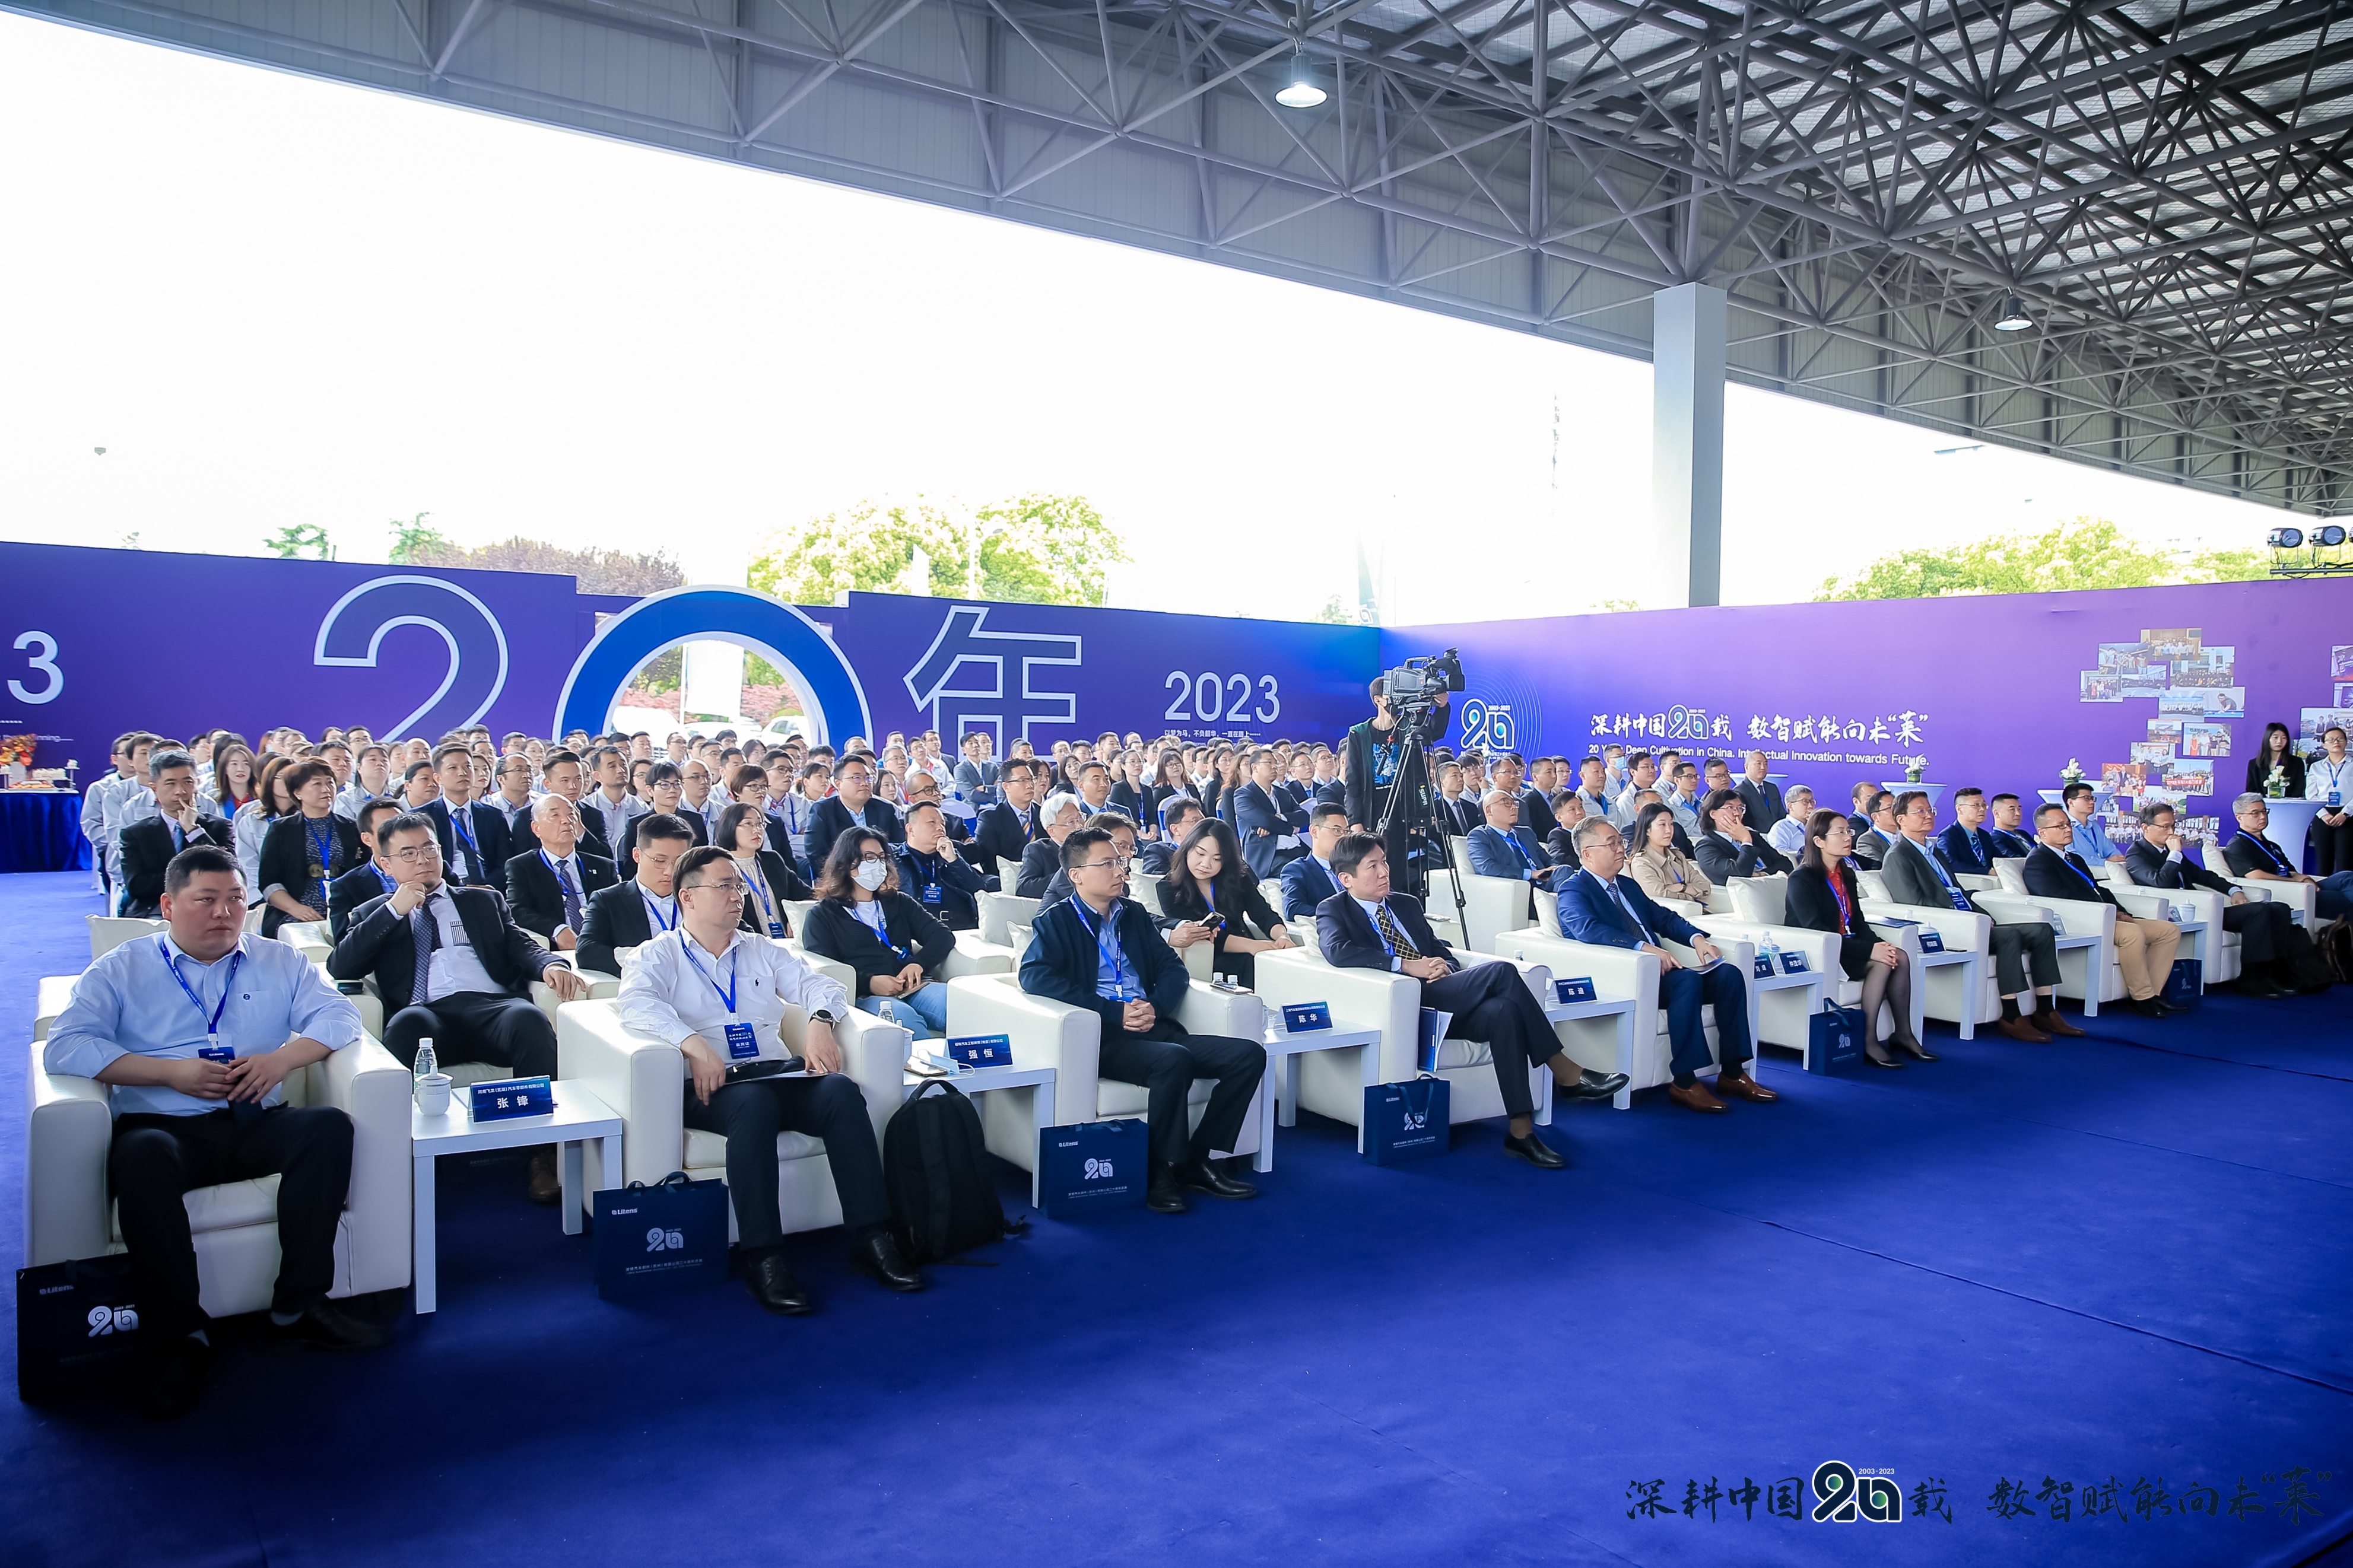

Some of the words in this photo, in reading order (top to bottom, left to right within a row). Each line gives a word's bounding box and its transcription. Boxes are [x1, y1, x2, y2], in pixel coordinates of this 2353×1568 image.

[1164, 670, 1280, 723] 2023
[1589, 744, 1599, 754] 20
[1697, 746, 1704, 757] in
[1707, 747, 1735, 758] China.
[1738, 748, 1789, 760] Inctual
[1791, 749, 1843, 762] Innovation
[1845, 752, 1888, 764] towards
[1891, 753, 1930, 766] Futue.
